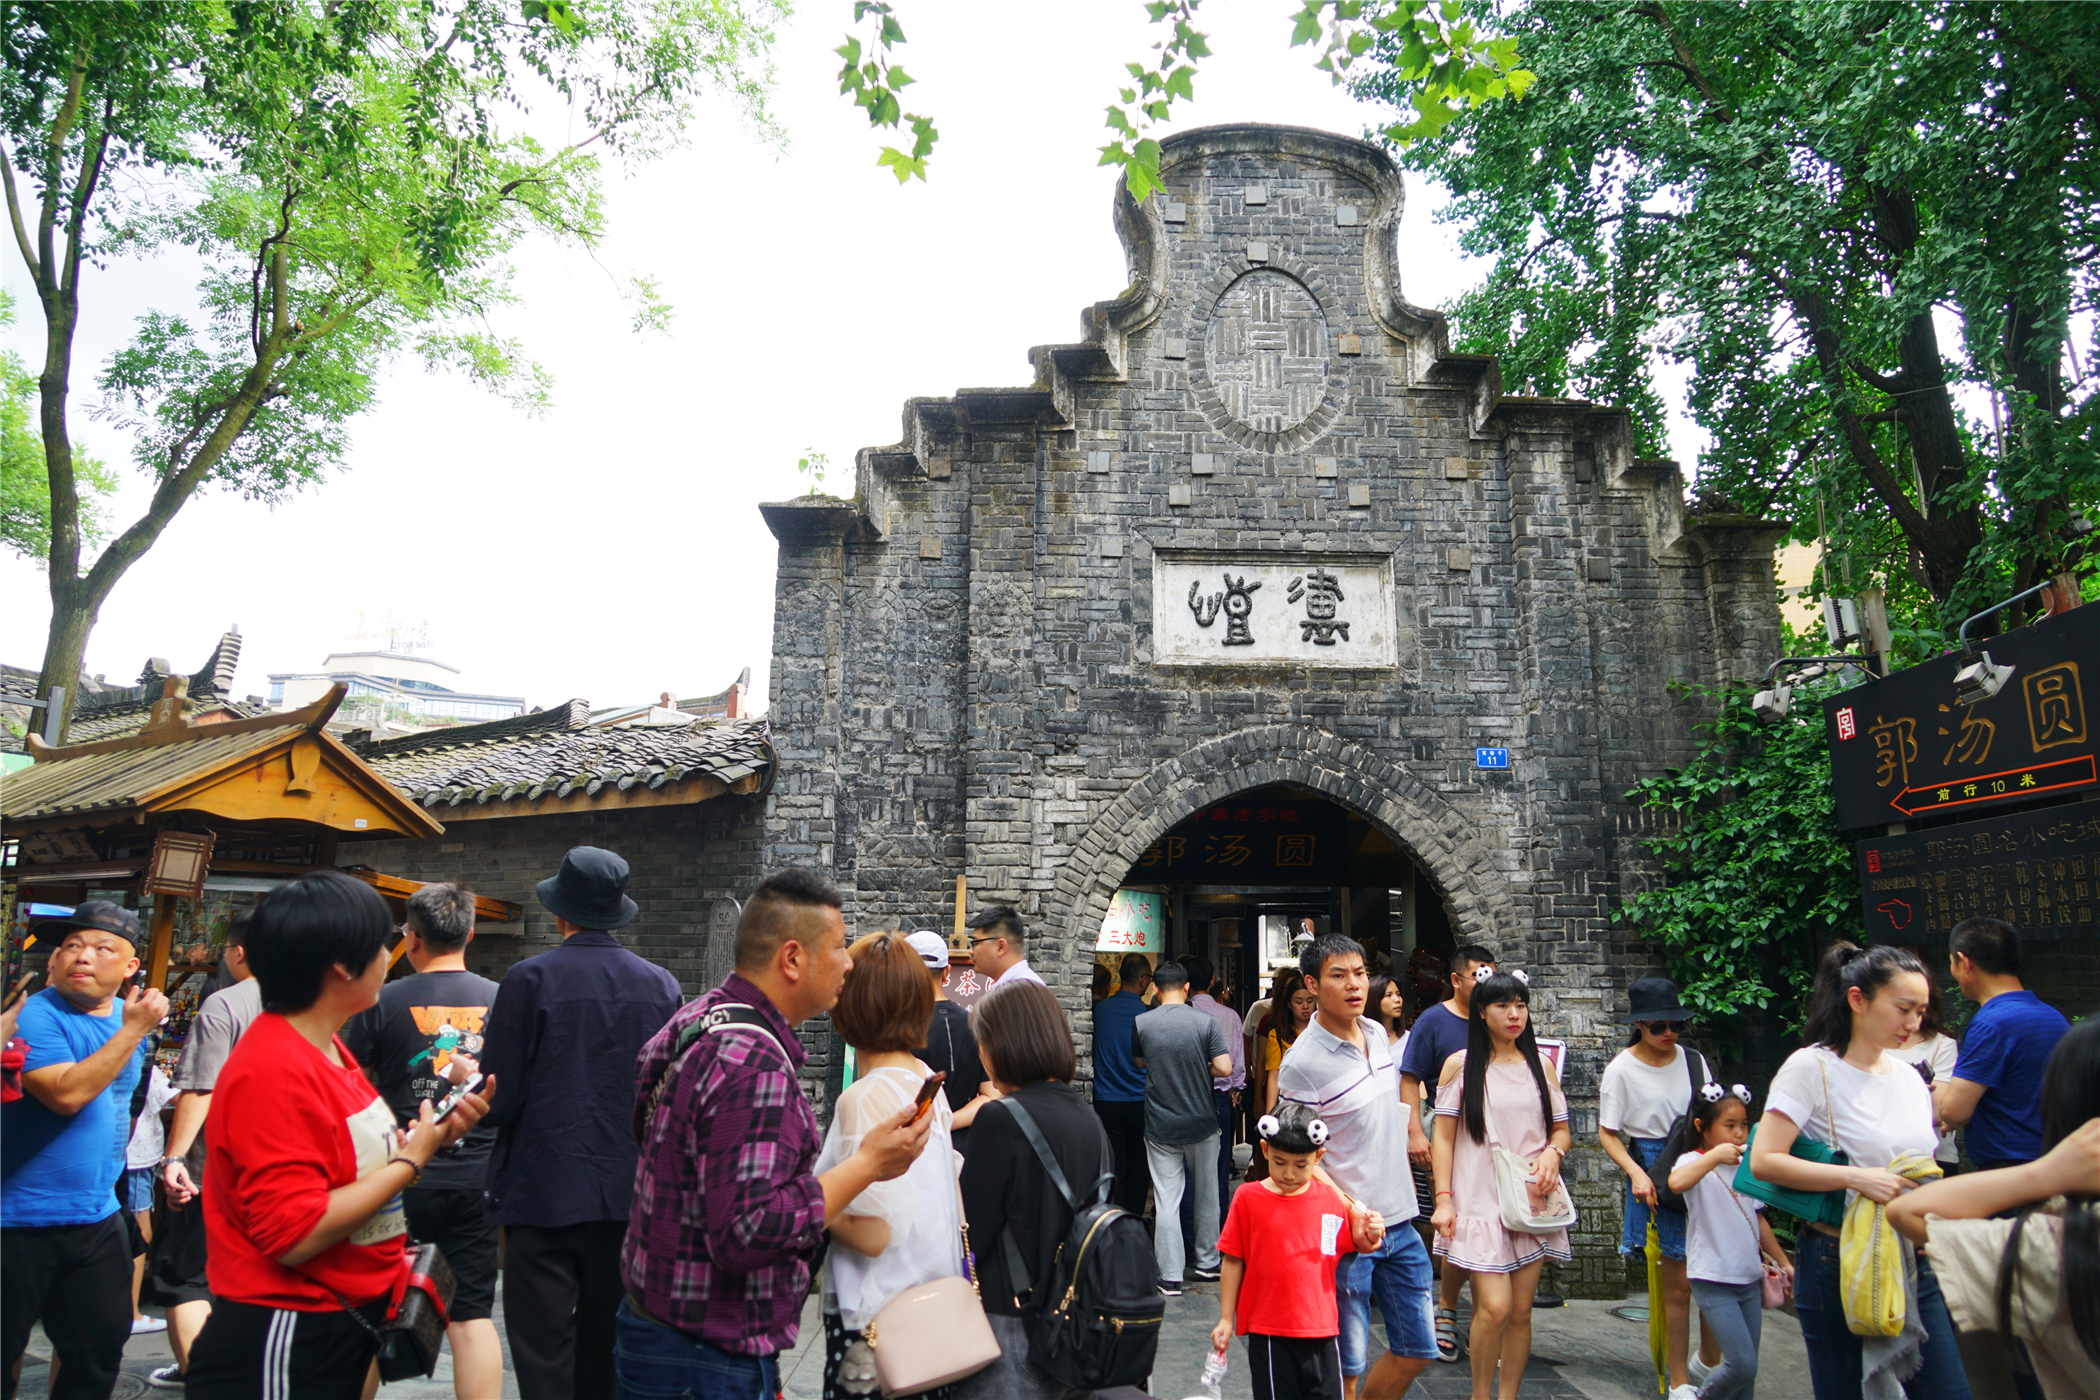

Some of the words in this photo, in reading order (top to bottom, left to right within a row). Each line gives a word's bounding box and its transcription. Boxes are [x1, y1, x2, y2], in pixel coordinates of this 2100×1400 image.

[1868, 661, 2087, 788] 郭汤圆
[1487, 756, 1497, 765] 11
[1140, 834, 1316, 868] 郭汤圆
[1108, 930, 1146, 947] 三大炮
[409, 1006, 489, 1036] VANS
[425, 1079, 439, 1090] THE
[415, 1089, 435, 1098] WALL
[378, 1219, 392, 1235] the
